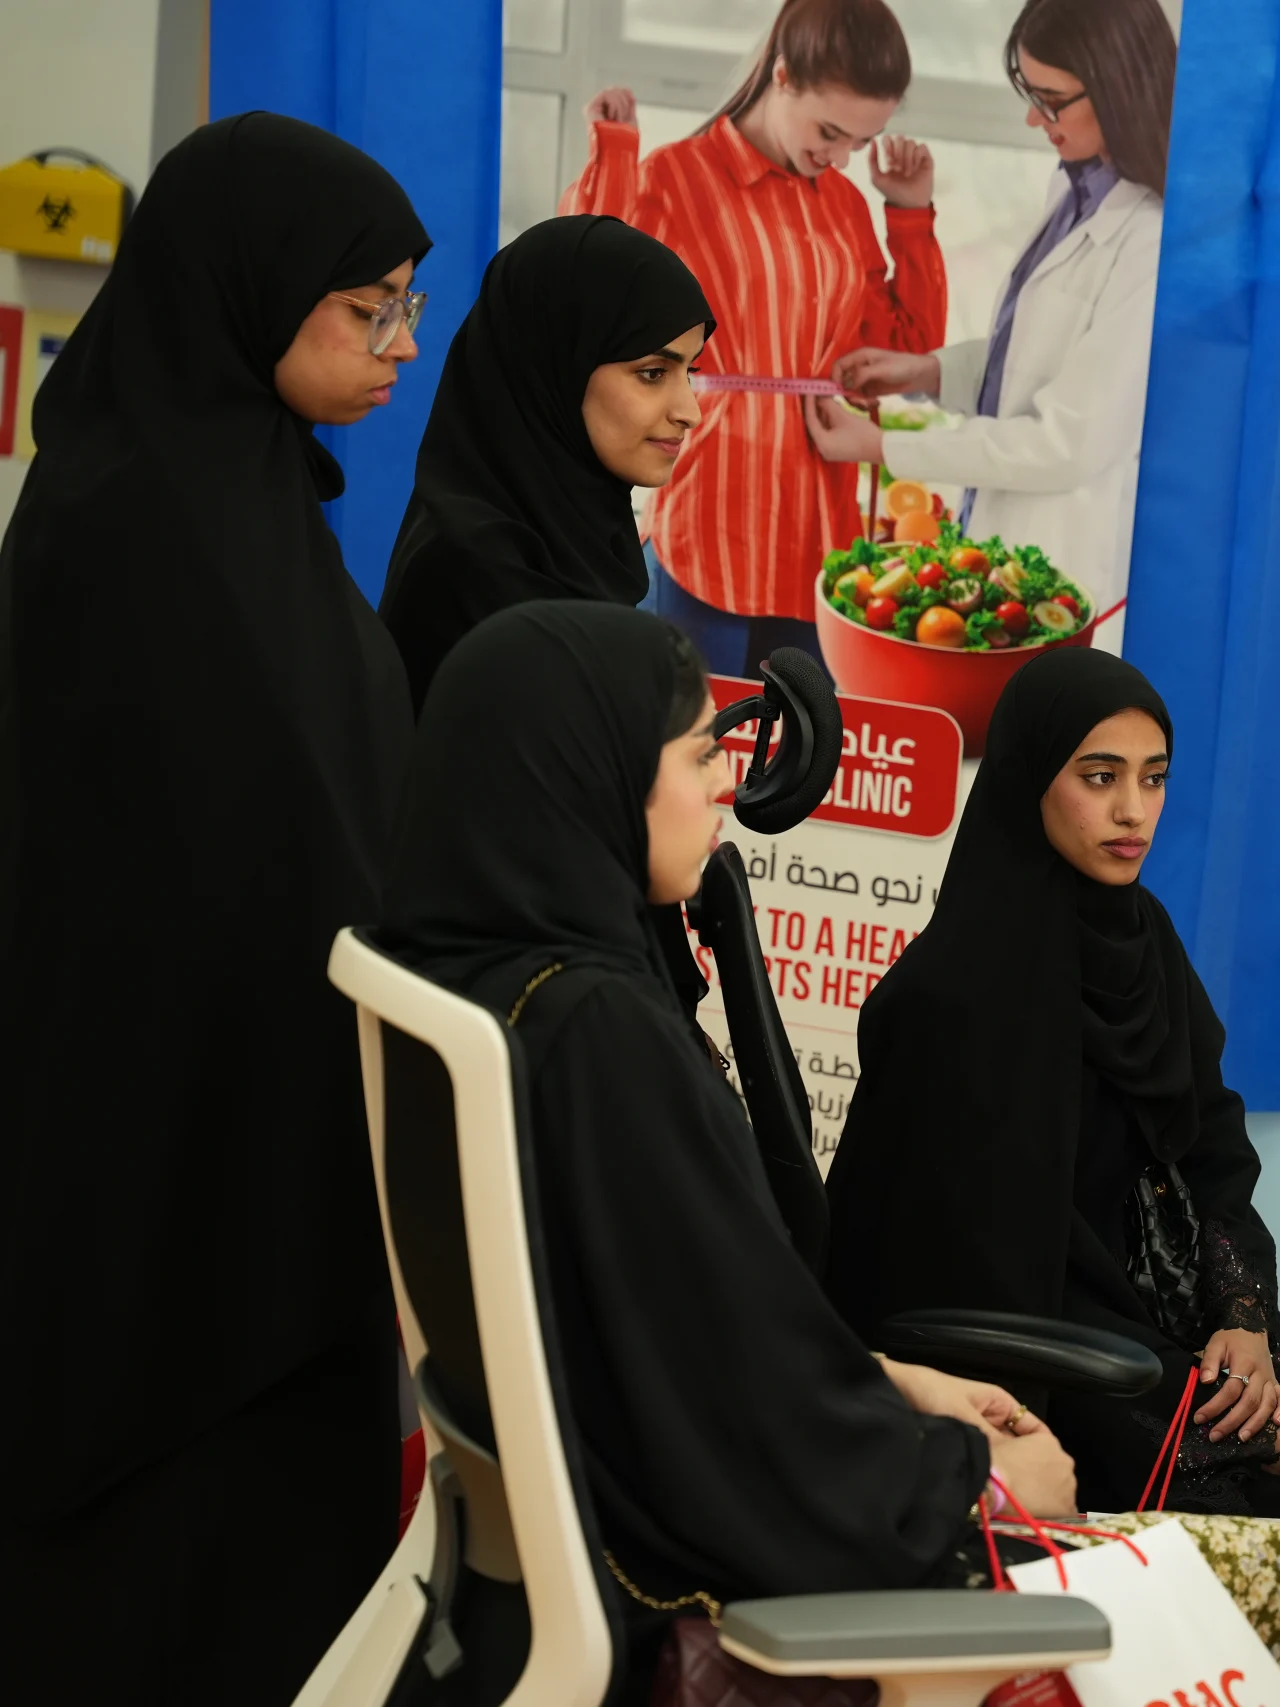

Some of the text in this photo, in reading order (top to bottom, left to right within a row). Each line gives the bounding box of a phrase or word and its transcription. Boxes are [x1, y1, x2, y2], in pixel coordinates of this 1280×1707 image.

[841, 722, 917, 771] عياد
[820, 765, 914, 818] LINIC
[786, 854, 860, 895] صحة
[871, 874, 924, 908] نحو
[767, 908, 919, 967] TO A HEA
